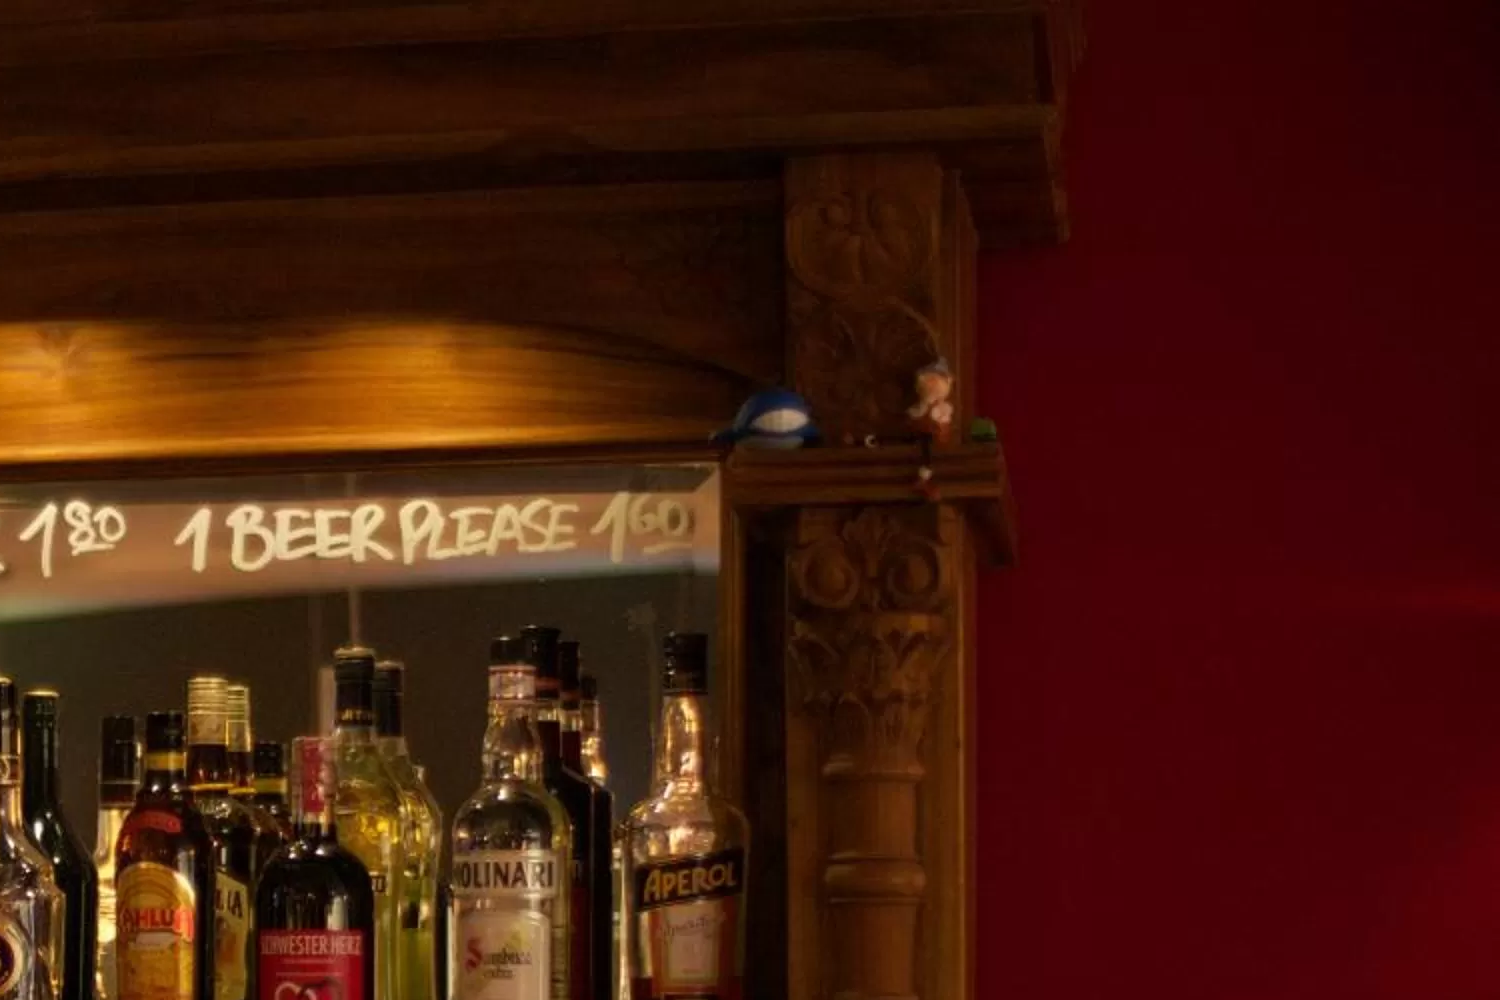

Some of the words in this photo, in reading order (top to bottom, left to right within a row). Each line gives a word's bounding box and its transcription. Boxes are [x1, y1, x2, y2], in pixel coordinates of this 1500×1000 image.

[174, 507, 211, 573] 1
[226, 503, 394, 573] BEER
[398, 499, 579, 565] PLEASE
[643, 860, 737, 903] APEROL
